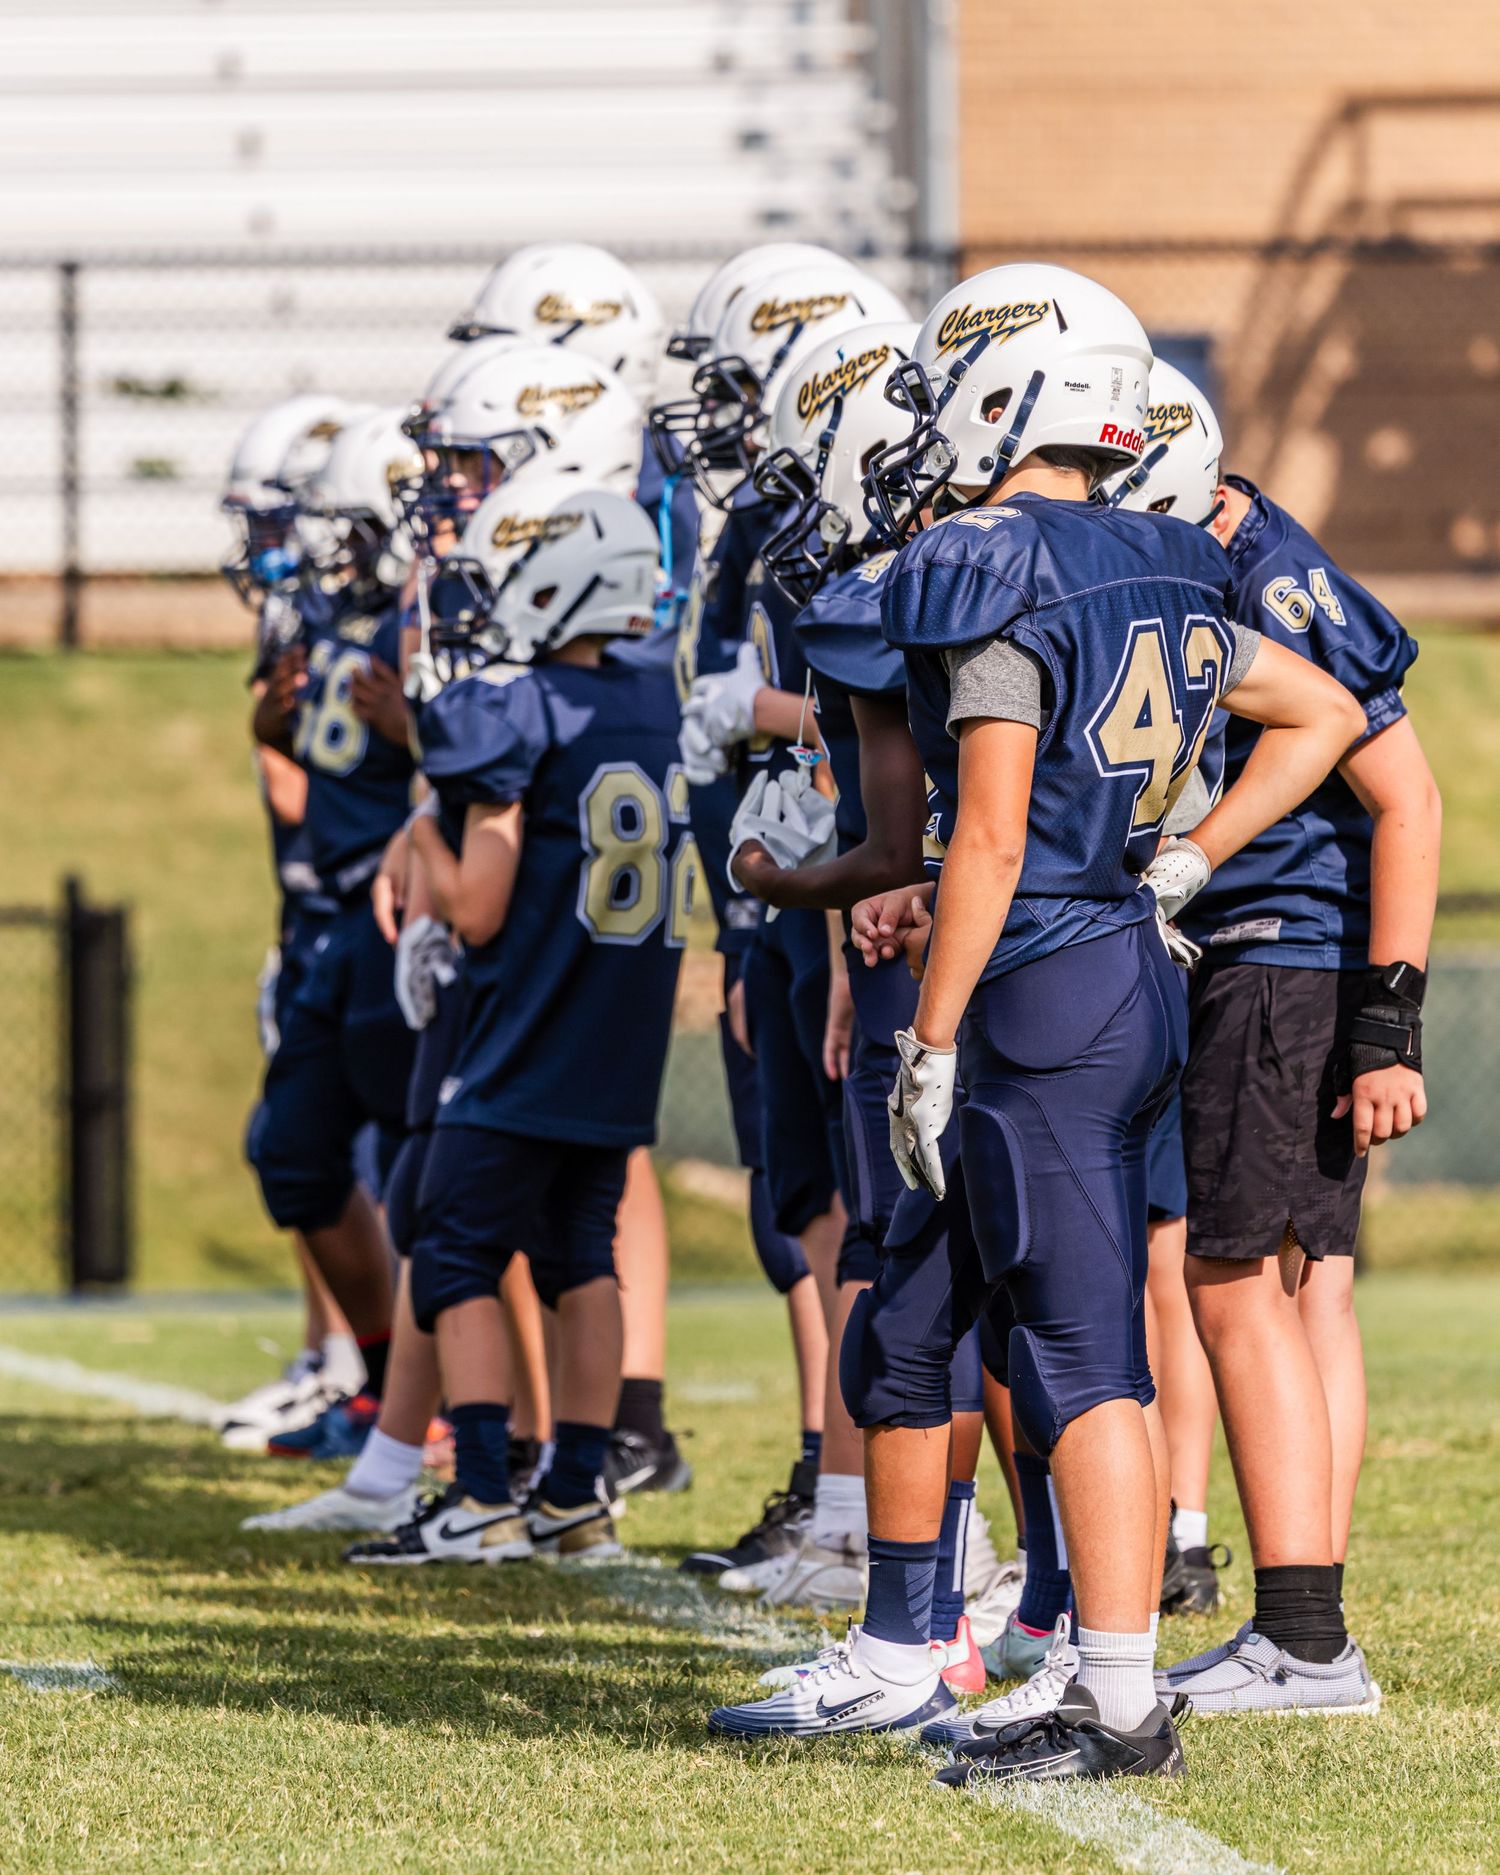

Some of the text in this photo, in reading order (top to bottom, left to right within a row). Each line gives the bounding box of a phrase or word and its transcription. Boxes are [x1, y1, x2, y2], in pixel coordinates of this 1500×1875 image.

[937, 301, 1050, 348] Chargers
[797, 344, 889, 420] Chargers
[1064, 381, 1089, 389] Riddell
[1099, 423, 1145, 455] Ridde
[1145, 402, 1193, 436] rgers
[1262, 568, 1346, 633] 64
[1084, 614, 1233, 848] 42
[825, 1692, 886, 1728] AIR ZOOM
